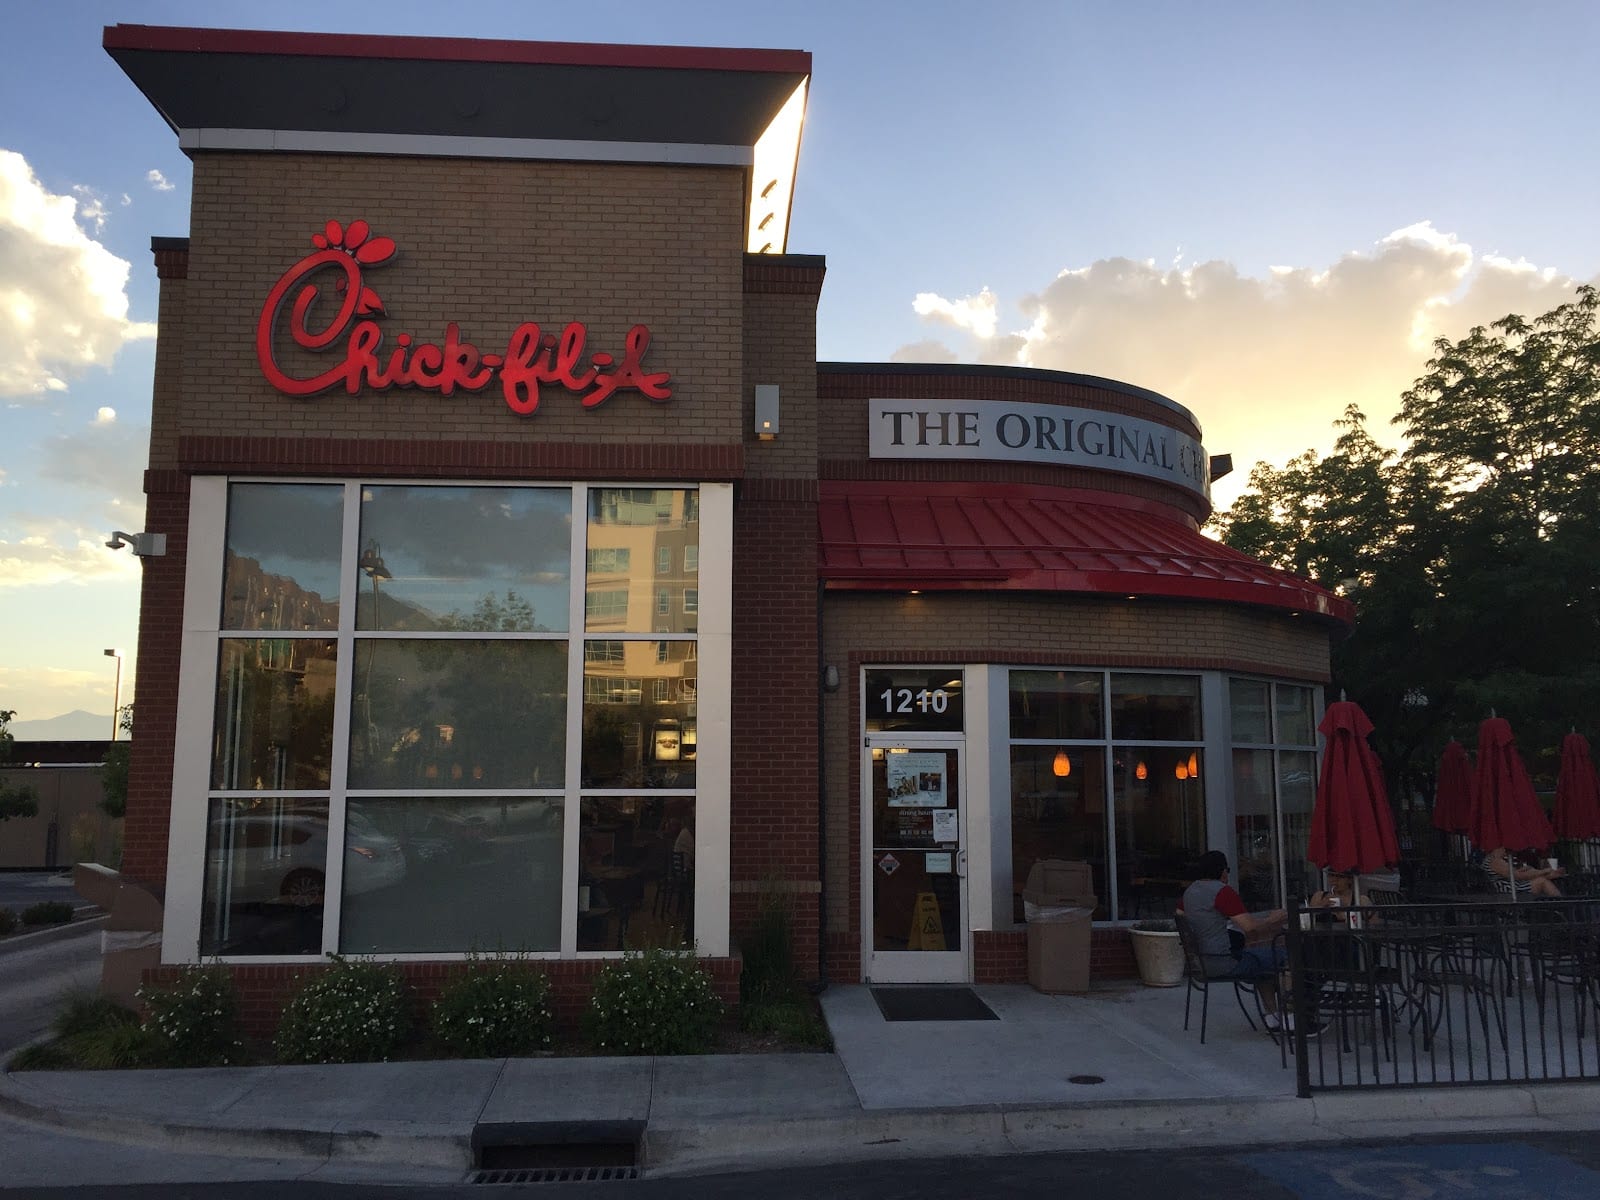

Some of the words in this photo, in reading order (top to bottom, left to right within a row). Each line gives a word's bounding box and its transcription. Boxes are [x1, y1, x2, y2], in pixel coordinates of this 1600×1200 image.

[256, 219, 672, 416] Chick-fil-A
[882, 411, 980, 447] THE
[996, 412, 1174, 471] ORIGINAL
[1180, 444, 1206, 485] CH
[880, 688, 948, 713] 1210
